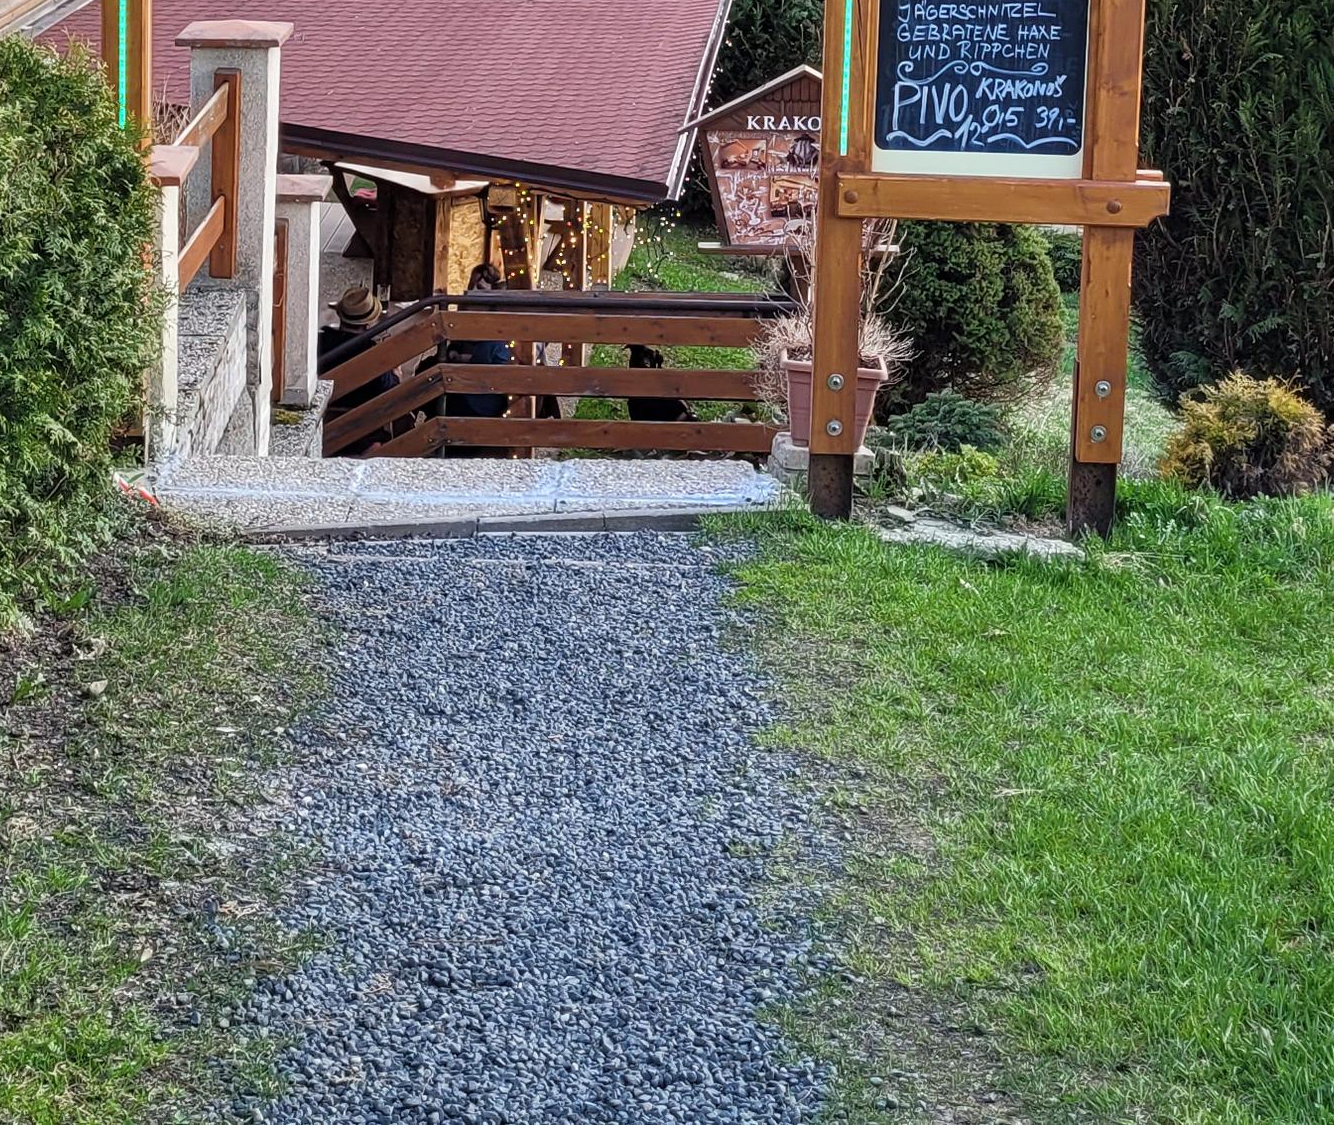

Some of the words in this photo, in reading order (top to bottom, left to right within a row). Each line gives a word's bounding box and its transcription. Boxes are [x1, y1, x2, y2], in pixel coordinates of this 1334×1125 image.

[898, 0, 1057, 23] JÄGERSCHNITZEL
[897, 23, 1010, 43] GEBRATENE
[1018, 24, 1062, 42] HAXE
[909, 43, 951, 61] UND
[956, 40, 1051, 60] RIPPCHEN
[892, 81, 968, 131] PIVO
[975, 74, 1068, 101] KRAKONOŠ
